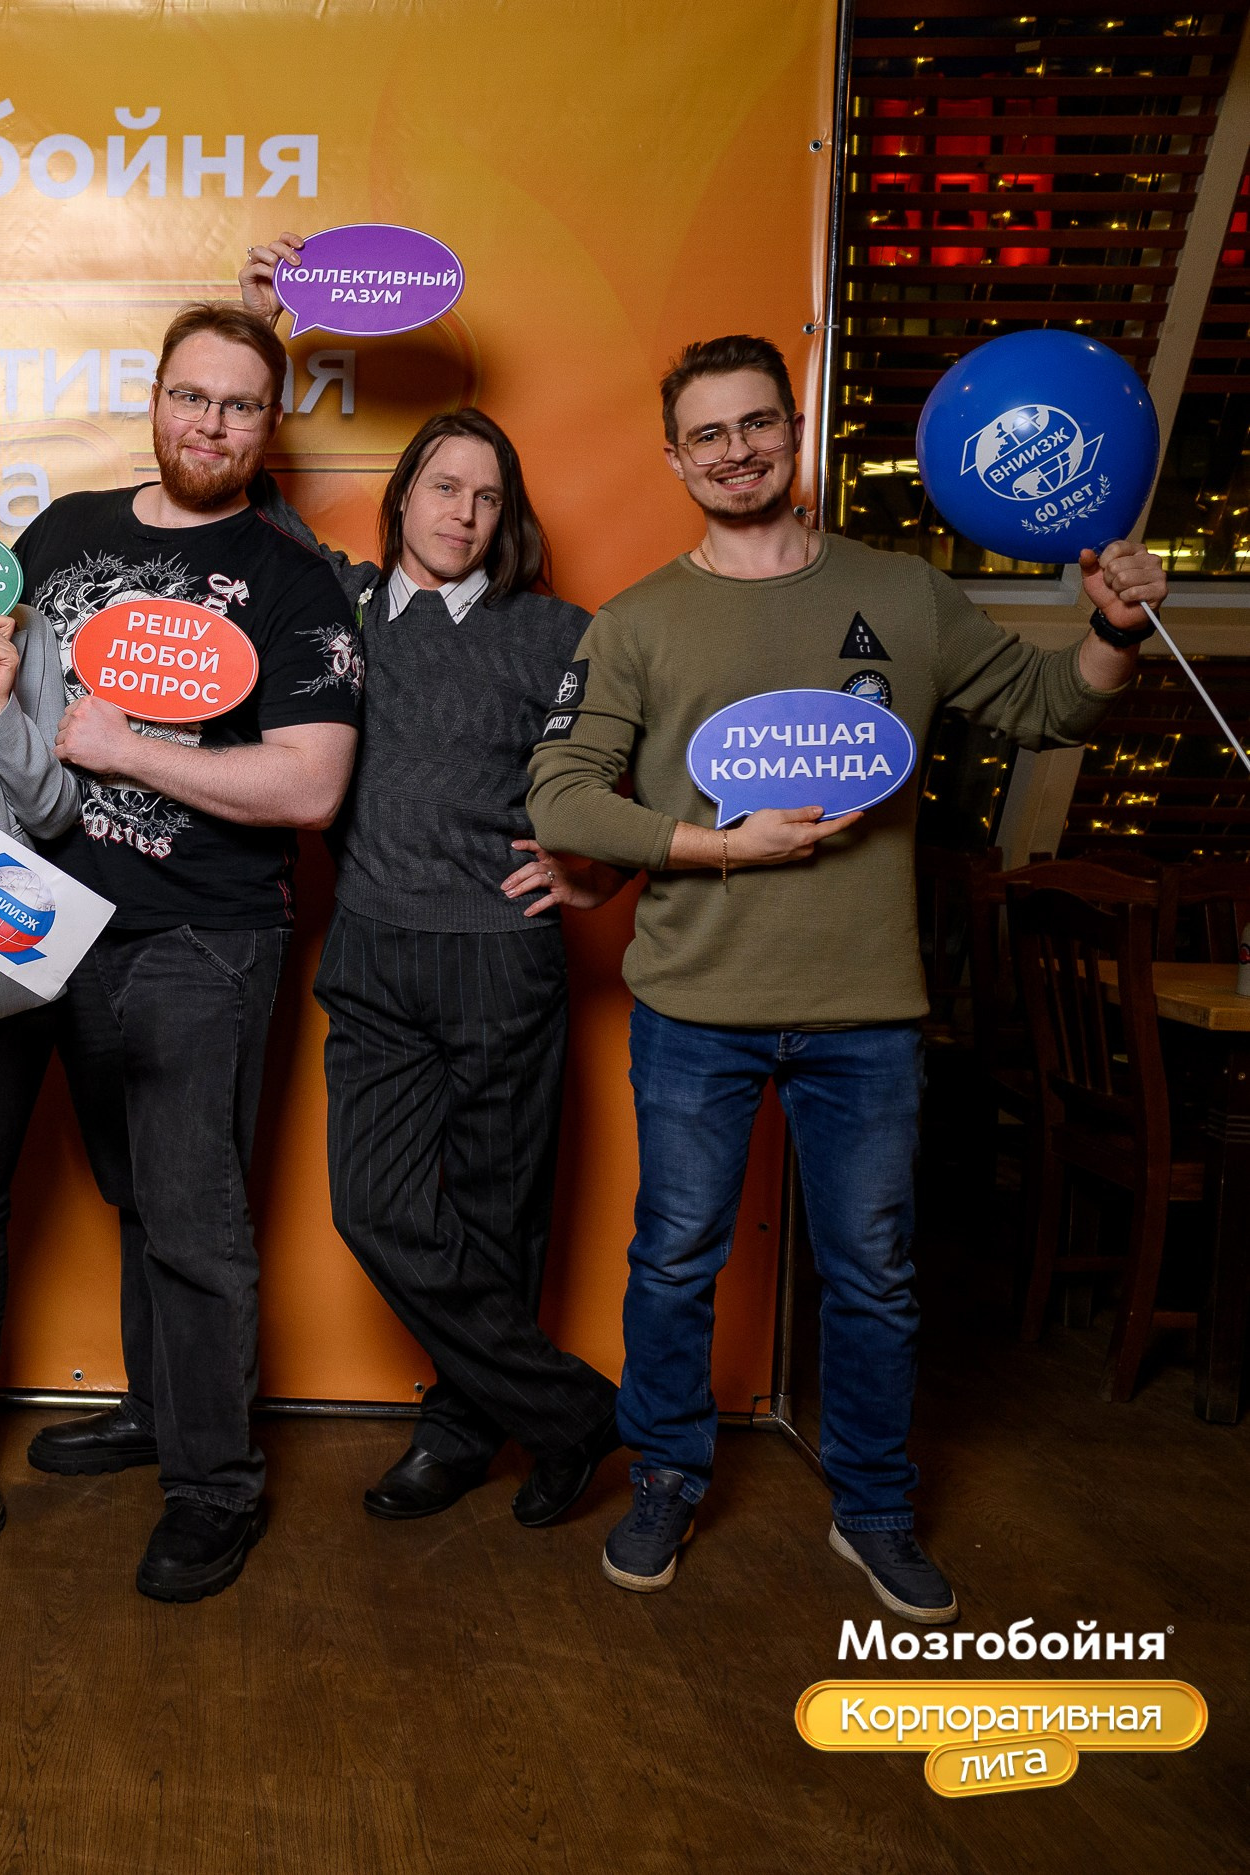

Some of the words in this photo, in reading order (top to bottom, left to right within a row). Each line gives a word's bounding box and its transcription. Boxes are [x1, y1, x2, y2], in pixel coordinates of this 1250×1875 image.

[281, 267, 458, 287] КОЛЛЕКТИВНЫЙ
[331, 288, 402, 304] РАЗУМ
[989, 426, 1070, 484] ВНИИЗЖ
[1034, 502, 1058, 523] 60
[1061, 482, 1095, 512] лет
[127, 610, 212, 641] РЕШУ
[106, 639, 221, 674] ЛЮБОЙ
[99, 667, 222, 704] ВОПРОС
[722, 722, 876, 749] ЛУЧШАЯ
[710, 754, 893, 781] КОМАНДА
